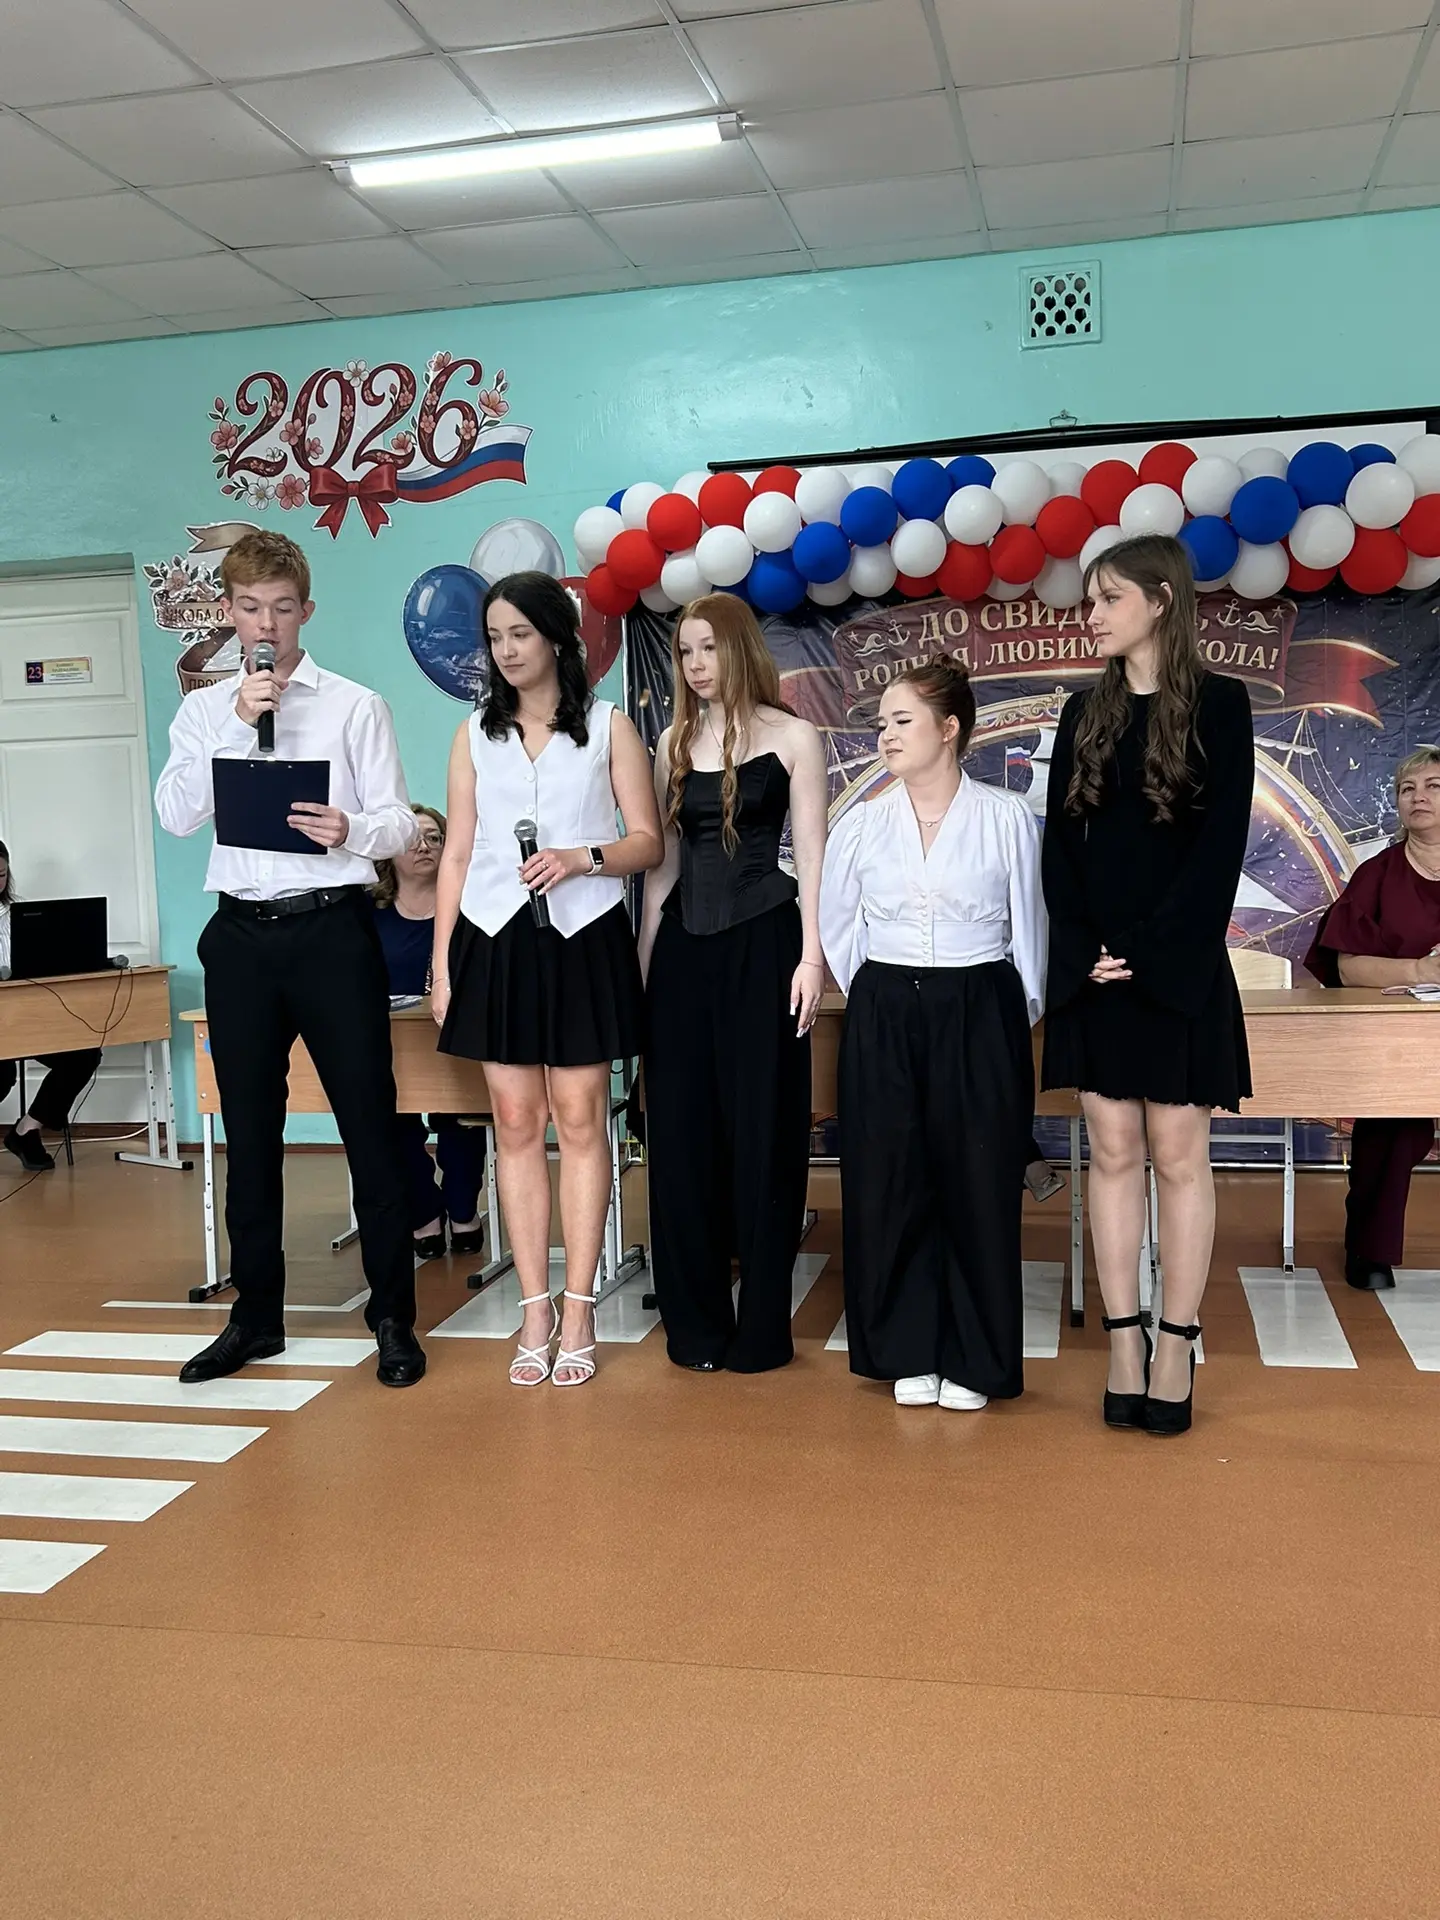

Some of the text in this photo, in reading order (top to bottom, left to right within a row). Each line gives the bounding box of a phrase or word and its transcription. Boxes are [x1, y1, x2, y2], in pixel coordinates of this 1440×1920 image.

[227, 357, 482, 479] 2026
[918, 607, 969, 648] ДО
[28, 667, 42, 678] 23
[853, 646, 978, 692] РОДНЯ,
[985, 636, 1103, 667] ЛЮБИМ
